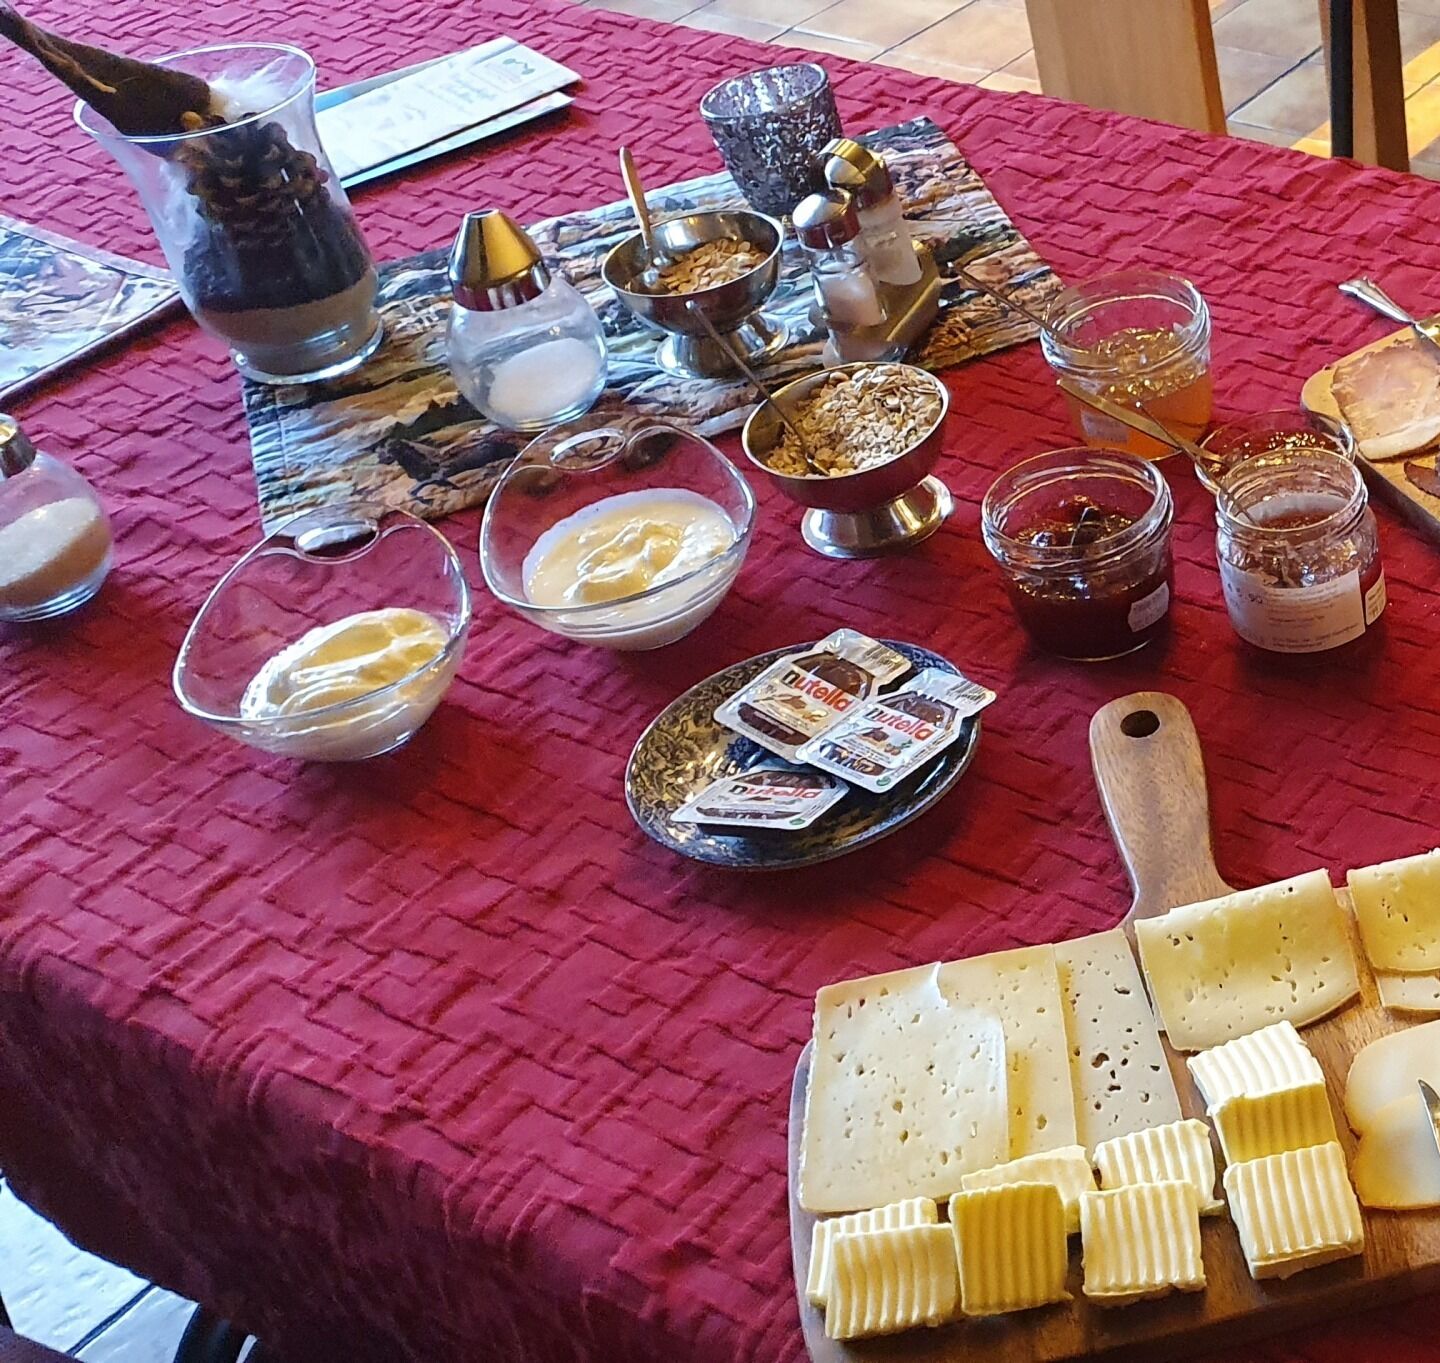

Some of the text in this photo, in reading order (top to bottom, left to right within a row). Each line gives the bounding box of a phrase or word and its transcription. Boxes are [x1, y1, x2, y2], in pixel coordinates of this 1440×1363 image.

[782, 669, 853, 712] nutella
[866, 707, 935, 741] nutella
[728, 784, 823, 800] nutella
